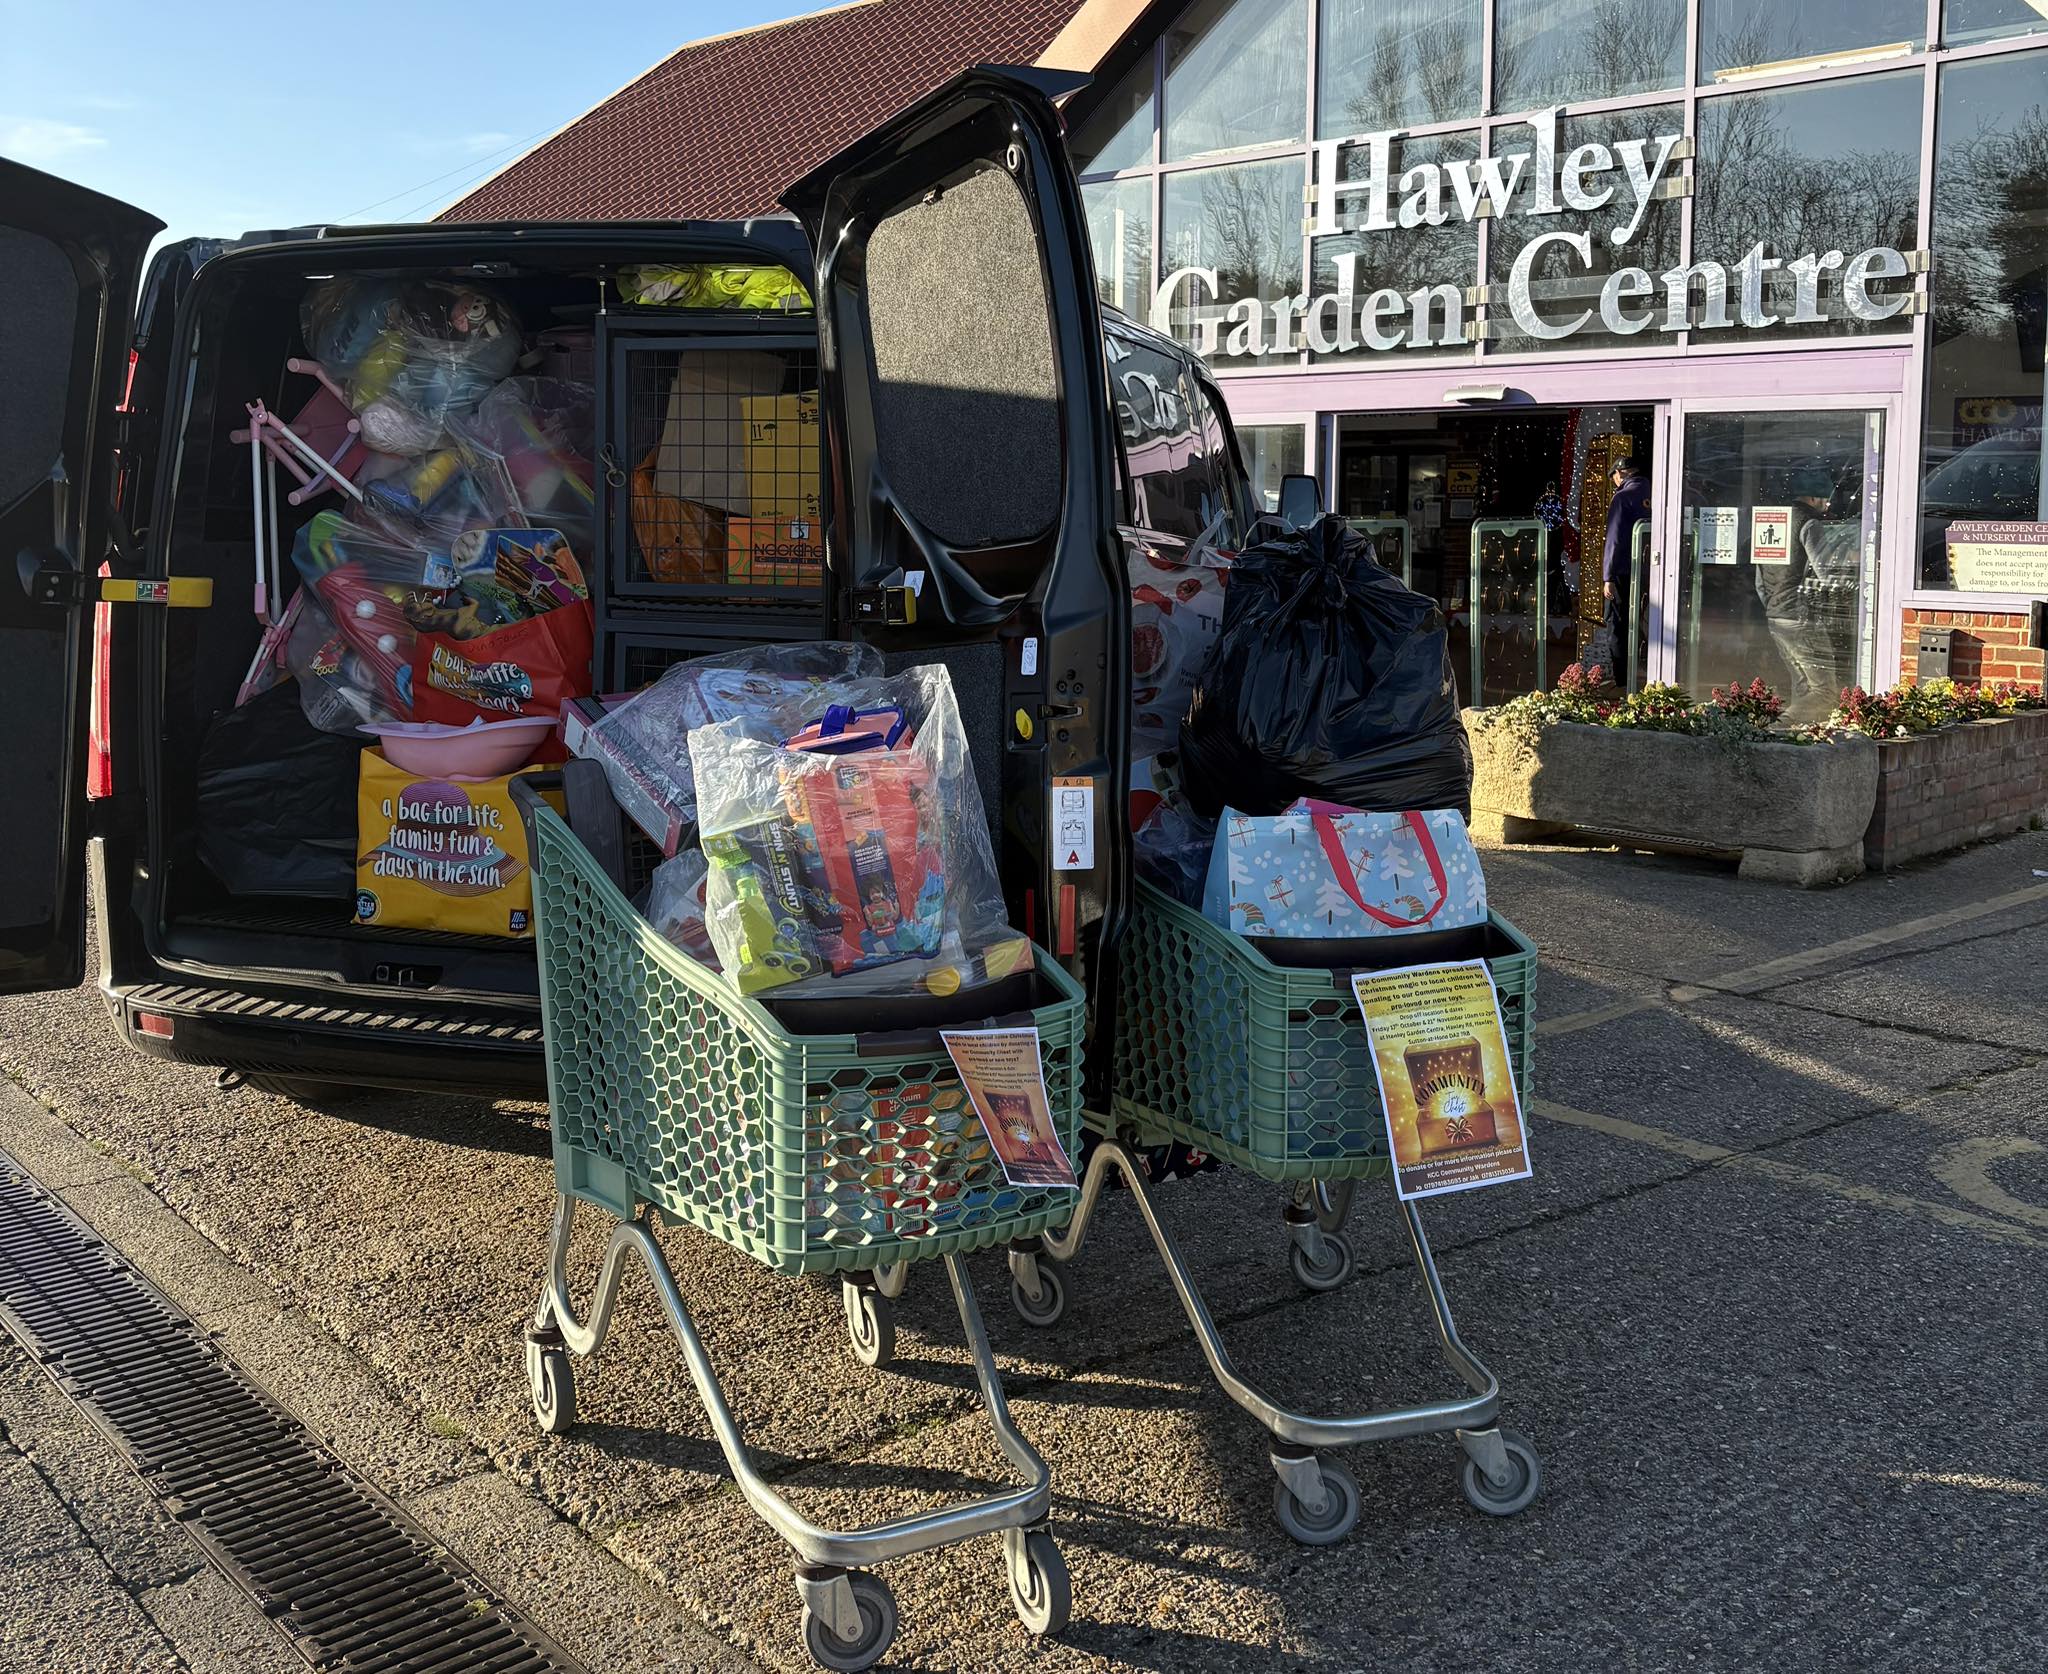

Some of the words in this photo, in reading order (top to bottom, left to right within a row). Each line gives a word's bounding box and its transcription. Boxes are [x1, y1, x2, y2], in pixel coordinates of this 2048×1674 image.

[1309, 106, 1680, 245] Hawley
[1153, 251, 1468, 356] Garden
[1508, 231, 1911, 340] Centre
[1991, 524, 2035, 532] GARDEN
[1962, 533, 1970, 541] &
[1972, 533, 2016, 541] NURSERY
[1976, 548, 1992, 556] The
[1994, 548, 2048, 558] Management
[2009, 561, 2033, 569] accept
[2034, 562, 2048, 570] any
[1970, 578, 1998, 588] damage
[1981, 570, 2032, 580] responsibility
[434, 647, 442, 664] a
[520, 684, 535, 699] &
[382, 798, 393, 818] a
[434, 800, 463, 825] for
[389, 824, 444, 854] family
[448, 830, 480, 856] fun
[483, 836, 495, 857] &
[374, 851, 414, 878] days
[417, 858, 434, 881] in
[438, 860, 467, 885] the
[468, 864, 506, 889] sun.
[769, 822, 784, 851] SPIN
[781, 866, 800, 908] STUNT
[1372, 974, 1410, 985] Community
[1412, 970, 1441, 978] Wardens
[1442, 966, 1464, 975] spread
[1360, 984, 1397, 996] Christmas
[1398, 982, 1419, 990] magic
[1447, 974, 1474, 983] children
[1475, 973, 1484, 981] by
[1414, 986, 1454, 997] Community
[1454, 983, 1474, 991] Chest
[1390, 1000, 1422, 1012] pre-loved
[1372, 1024, 1390, 1033] Friday
[1400, 1020, 1422, 1029] October
[1436, 1014, 1464, 1024] November
[1400, 1012, 1414, 1022] Drop
[1406, 1028, 1426, 1037] Garden
[1446, 1022, 1464, 1032] Hawley
[1414, 1074, 1488, 1106] COMMUNITY
[1443, 1099, 1467, 1114] Chest
[1406, 1164, 1427, 1173] donate
[1460, 1152, 1495, 1164] information
[1495, 1148, 1512, 1158] please
[1440, 1165, 1474, 1176] Community
[1474, 1160, 1500, 1170] Wardens
